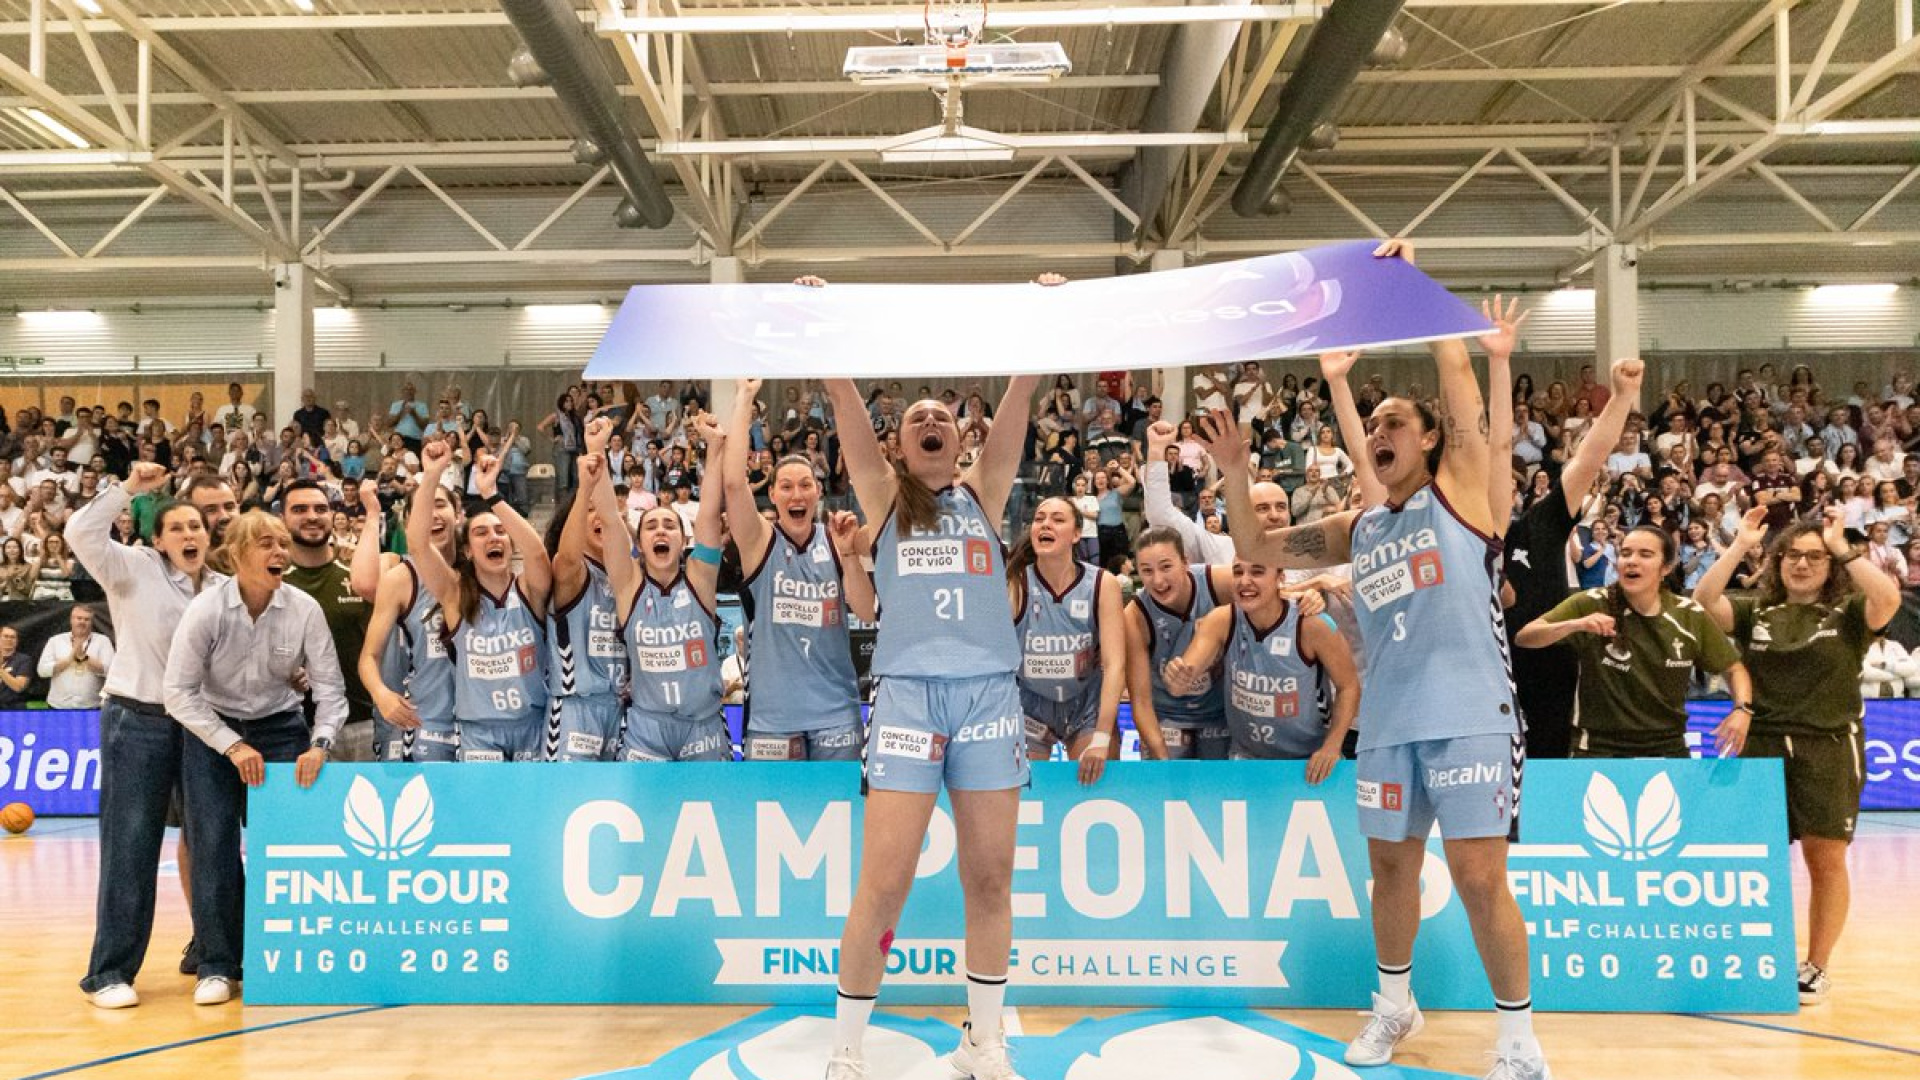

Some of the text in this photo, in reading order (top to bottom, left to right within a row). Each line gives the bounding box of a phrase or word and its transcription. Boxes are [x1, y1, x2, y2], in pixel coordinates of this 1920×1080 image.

[755, 322, 846, 337] LF
[902, 545, 959, 558] CONCELLO
[908, 556, 953, 567] DE VIGO
[774, 571, 839, 598] femxa
[1379, 581, 1403, 597] VIGO
[775, 602, 819, 613] CONCELLO
[933, 587, 964, 620] 21
[795, 612, 814, 621] VIGO
[465, 627, 535, 654] femxa
[635, 620, 703, 645] femxa
[1025, 630, 1092, 652] femxa
[640, 650, 681, 660] CONCELLO
[800, 637, 811, 659] 7
[470, 656, 514, 668] CONCELLO
[489, 666, 510, 675] VIGO
[1027, 658, 1071, 667] CONCELLO
[492, 687, 522, 711] 66
[661, 682, 681, 705] 11
[1056, 686, 1064, 702] 1
[881, 731, 927, 745] CONCELLO
[952, 714, 1019, 742] ecalvi
[1249, 722, 1276, 745] 32
[679, 735, 721, 758] ecalvi
[884, 741, 921, 753] DE VIGO
[1428, 762, 1503, 788] Recalvi
[266, 869, 510, 905] FINAL FOUR
[1507, 870, 1770, 907] FINAL FOUR
[300, 917, 473, 935] LF CHALLENGE
[1545, 919, 1733, 939] LF CHALLENGE
[264, 949, 510, 973] VIGO 2026
[886, 948, 956, 975] OUR
[1031, 954, 1239, 976] CHALLENGE
[1541, 954, 1777, 979] IGO 2026
